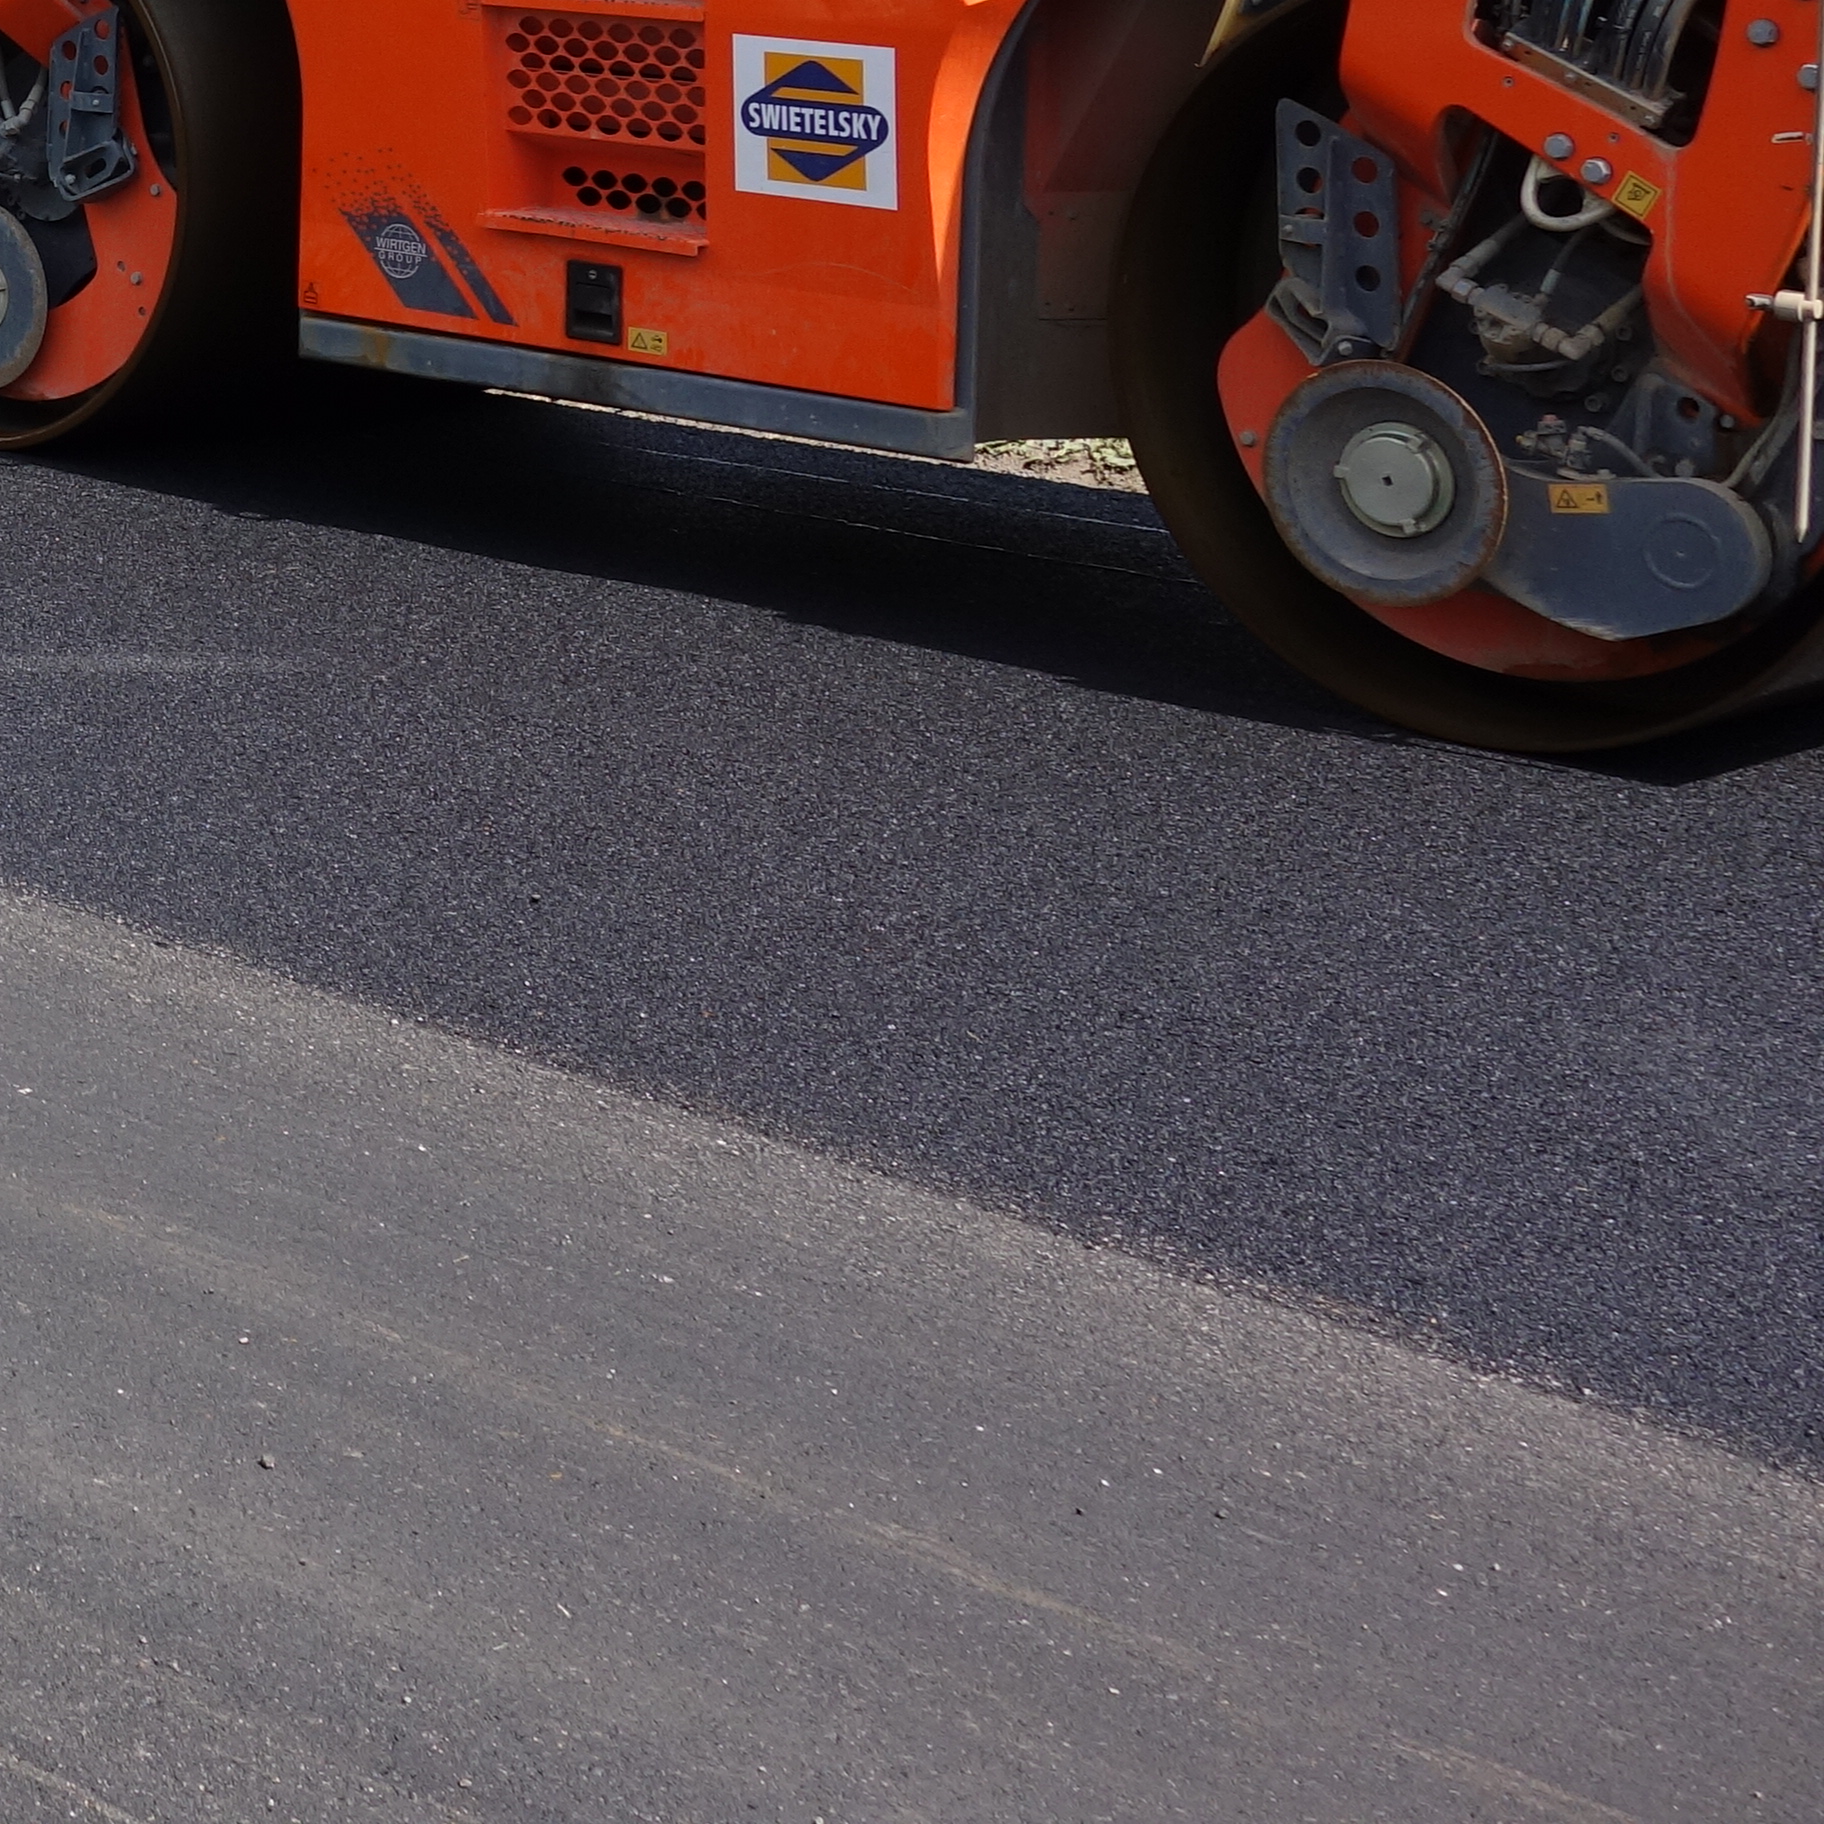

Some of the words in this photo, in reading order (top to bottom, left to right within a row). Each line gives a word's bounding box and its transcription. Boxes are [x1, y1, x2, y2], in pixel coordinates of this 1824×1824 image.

[747, 102, 882, 141] SWIETELSKY
[376, 236, 427, 254] WIRTGEN
[378, 250, 422, 264] GROUP
